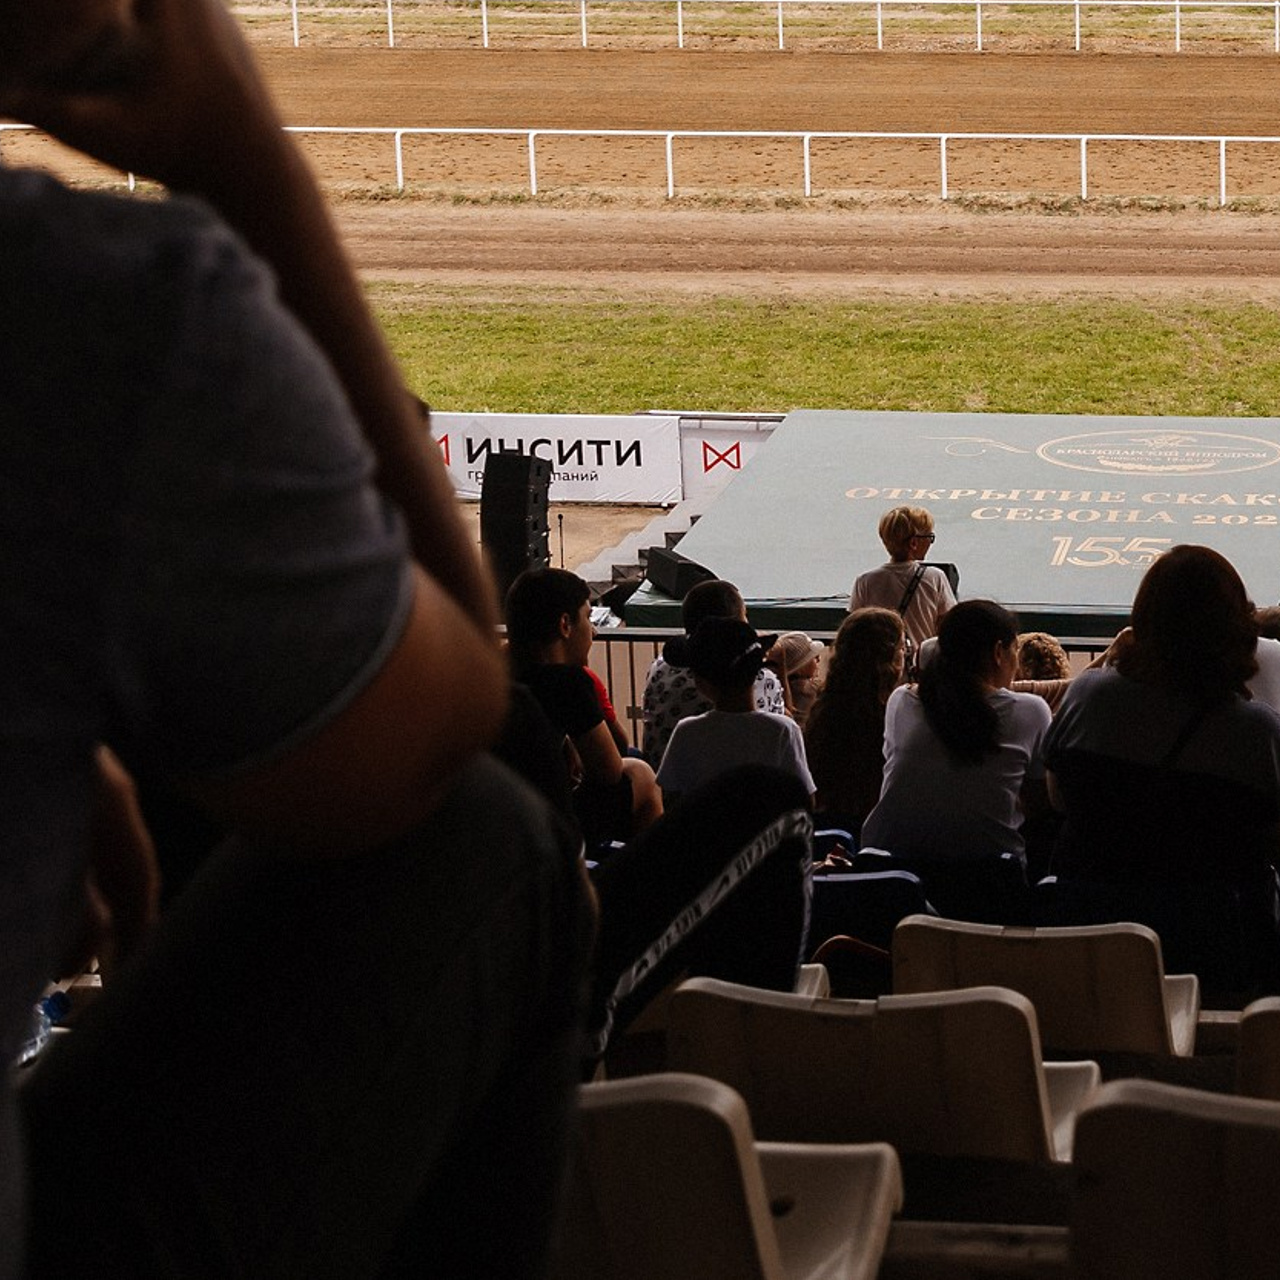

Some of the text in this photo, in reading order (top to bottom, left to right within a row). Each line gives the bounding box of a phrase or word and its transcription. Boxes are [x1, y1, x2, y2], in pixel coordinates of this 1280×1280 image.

[553, 470, 599, 481] паний
[845, 486, 1126, 503] ОТКРЫТИЕ
[970, 506, 1177, 524] СЕЗОНА
[1050, 536, 1173, 567] 155
